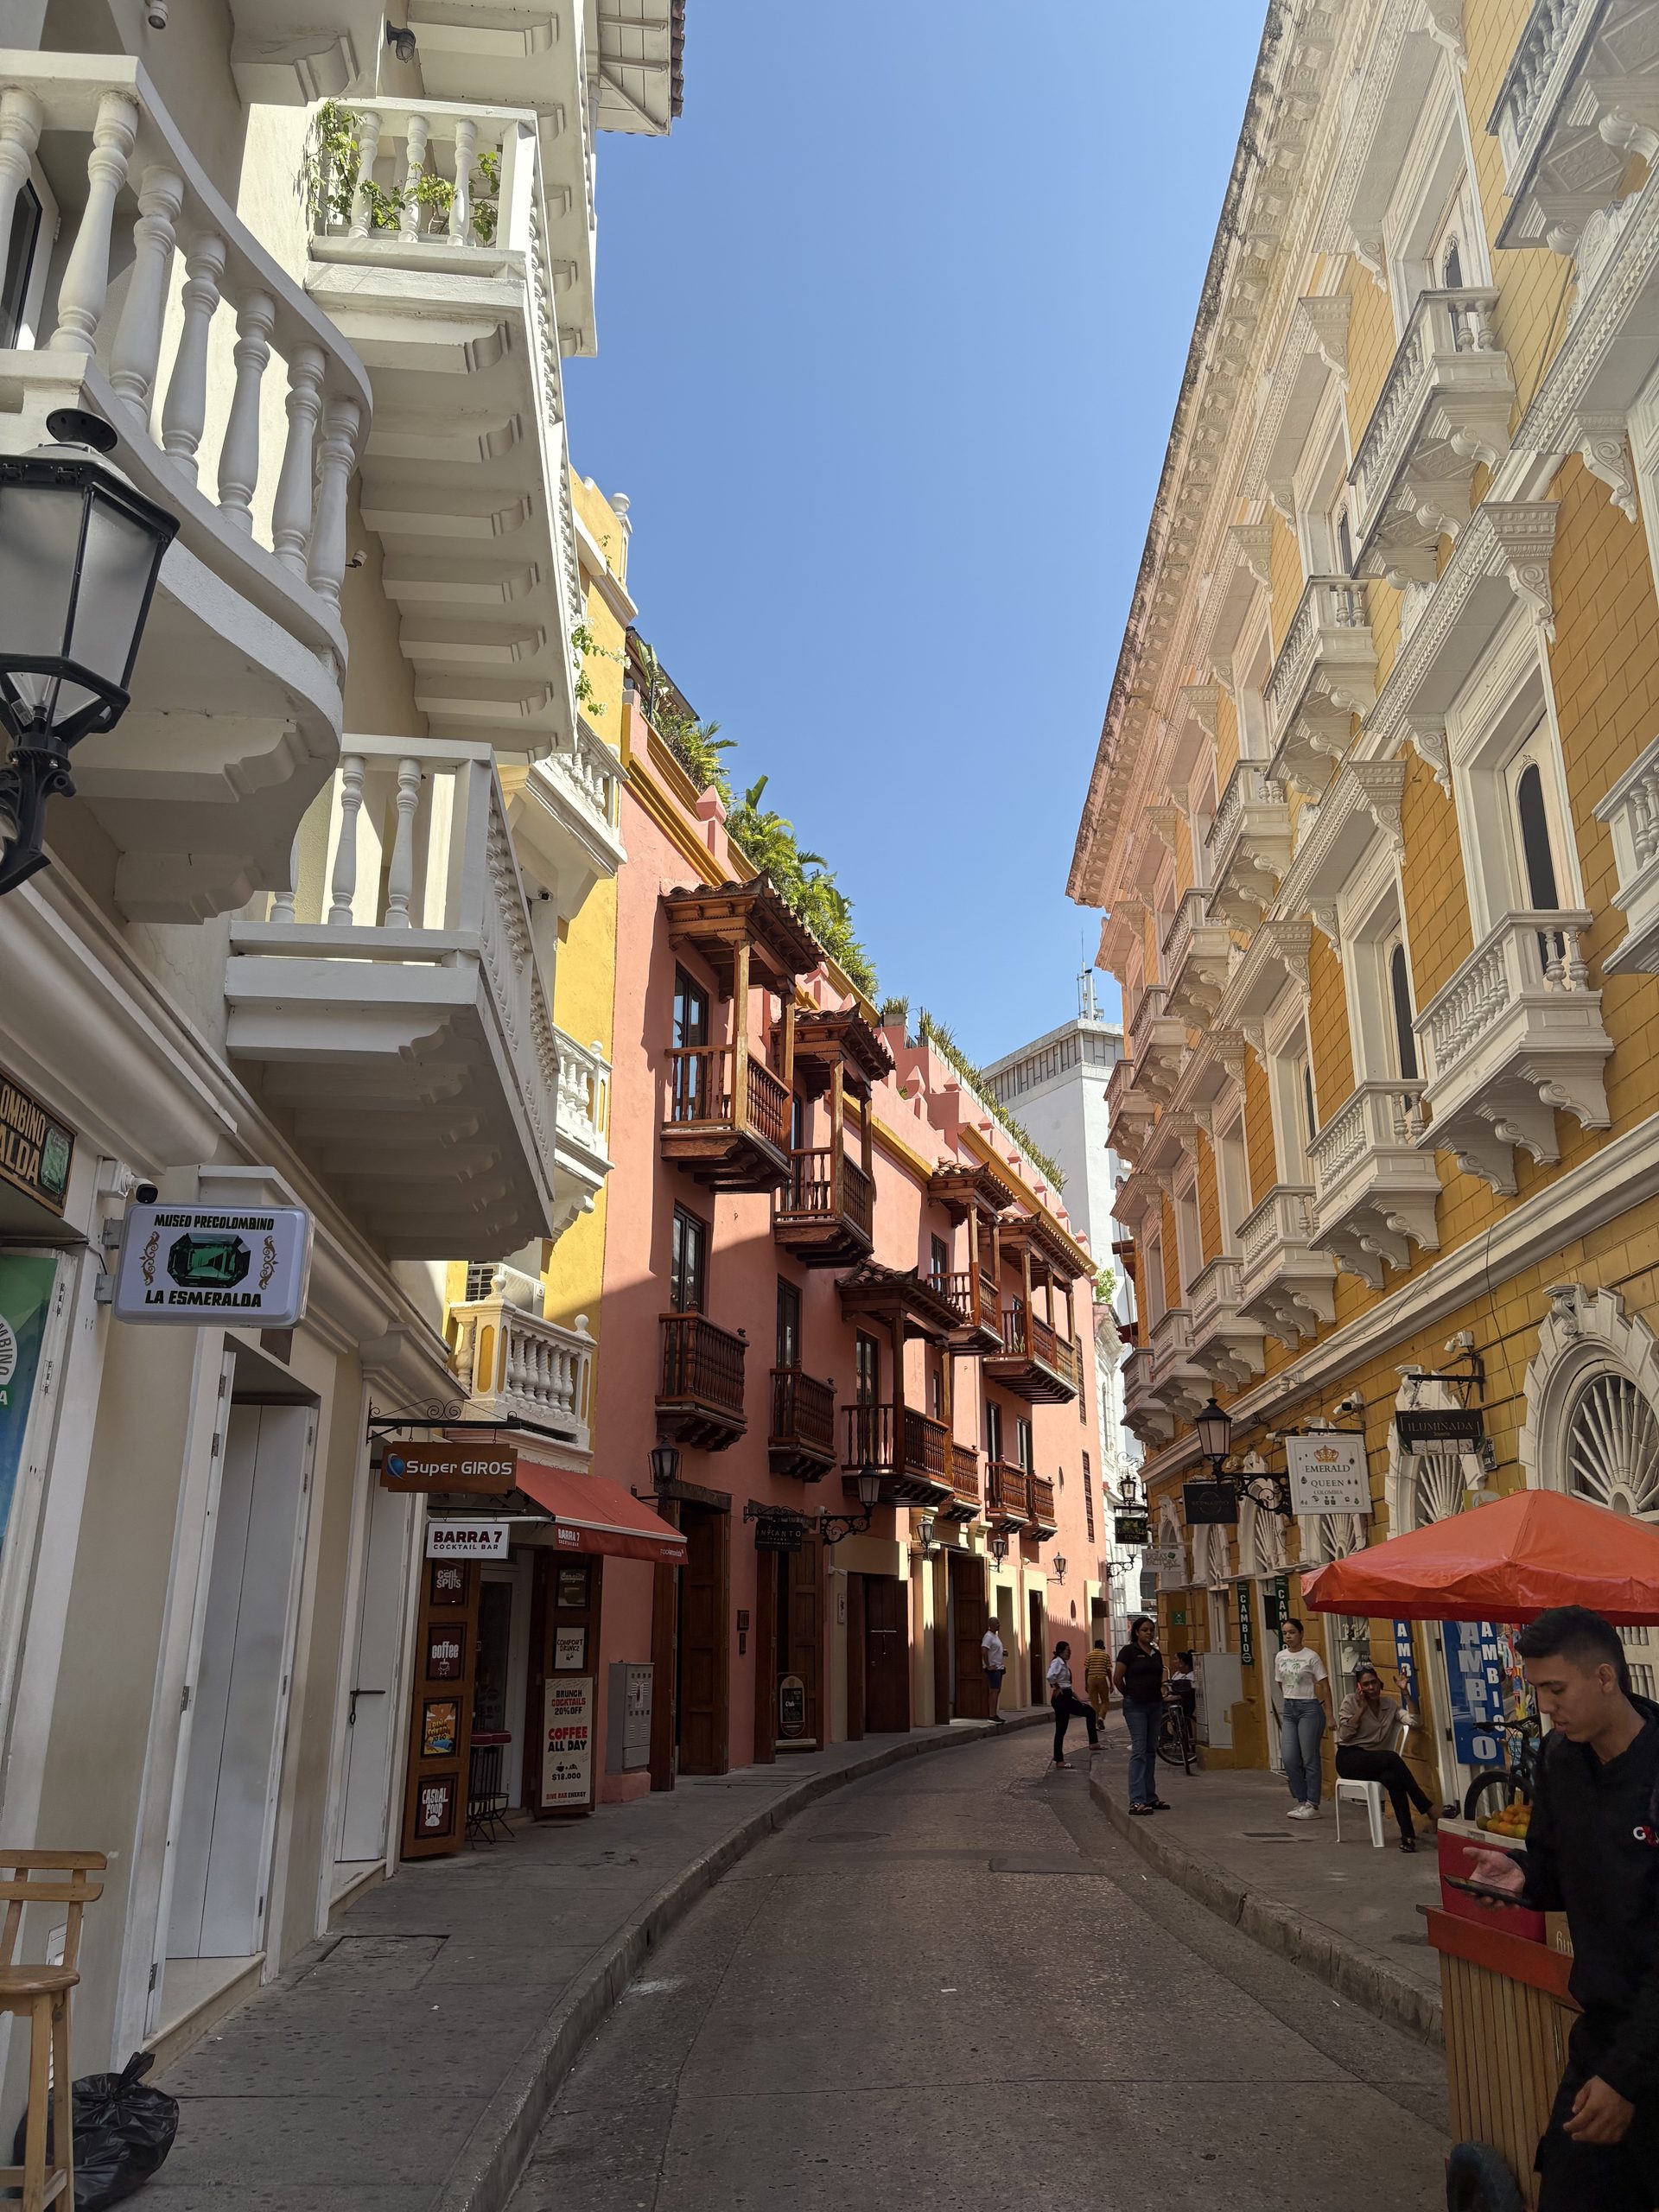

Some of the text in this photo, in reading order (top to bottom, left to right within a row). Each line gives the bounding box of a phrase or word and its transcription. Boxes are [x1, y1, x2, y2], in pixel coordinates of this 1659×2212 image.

[154, 1213, 275, 1231] MUSEO PRECOLOMBINO
[144, 1289, 262, 1307] LA ESMERALDA
[1408, 1421, 1473, 1432] ILUMINADA
[461, 1460, 512, 1475] GIROS
[1305, 1465, 1351, 1473] EMERALD
[1310, 1479, 1344, 1488] QUEEN
[433, 1530, 502, 1543] BARRA 7
[557, 1528, 581, 1541] BARRA 7
[1239, 1594, 1249, 1652] CAMBIO
[1278, 1589, 1288, 1650] CAMO
[431, 1640, 459, 1659] coffee
[1481, 1621, 1506, 1732] AMBIO
[556, 1689, 582, 1698] BRUNCH
[1458, 1621, 1497, 1760] AMBIO
[551, 1697, 587, 1707] COCKTAILS
[548, 1726, 588, 1740] COFFEE
[548, 1740, 588, 1752] ALL DAY
[551, 1772, 582, 1781] $18.000
[422, 1787, 449, 1804] CASUAL
[426, 1802, 443, 1820] FOOD
